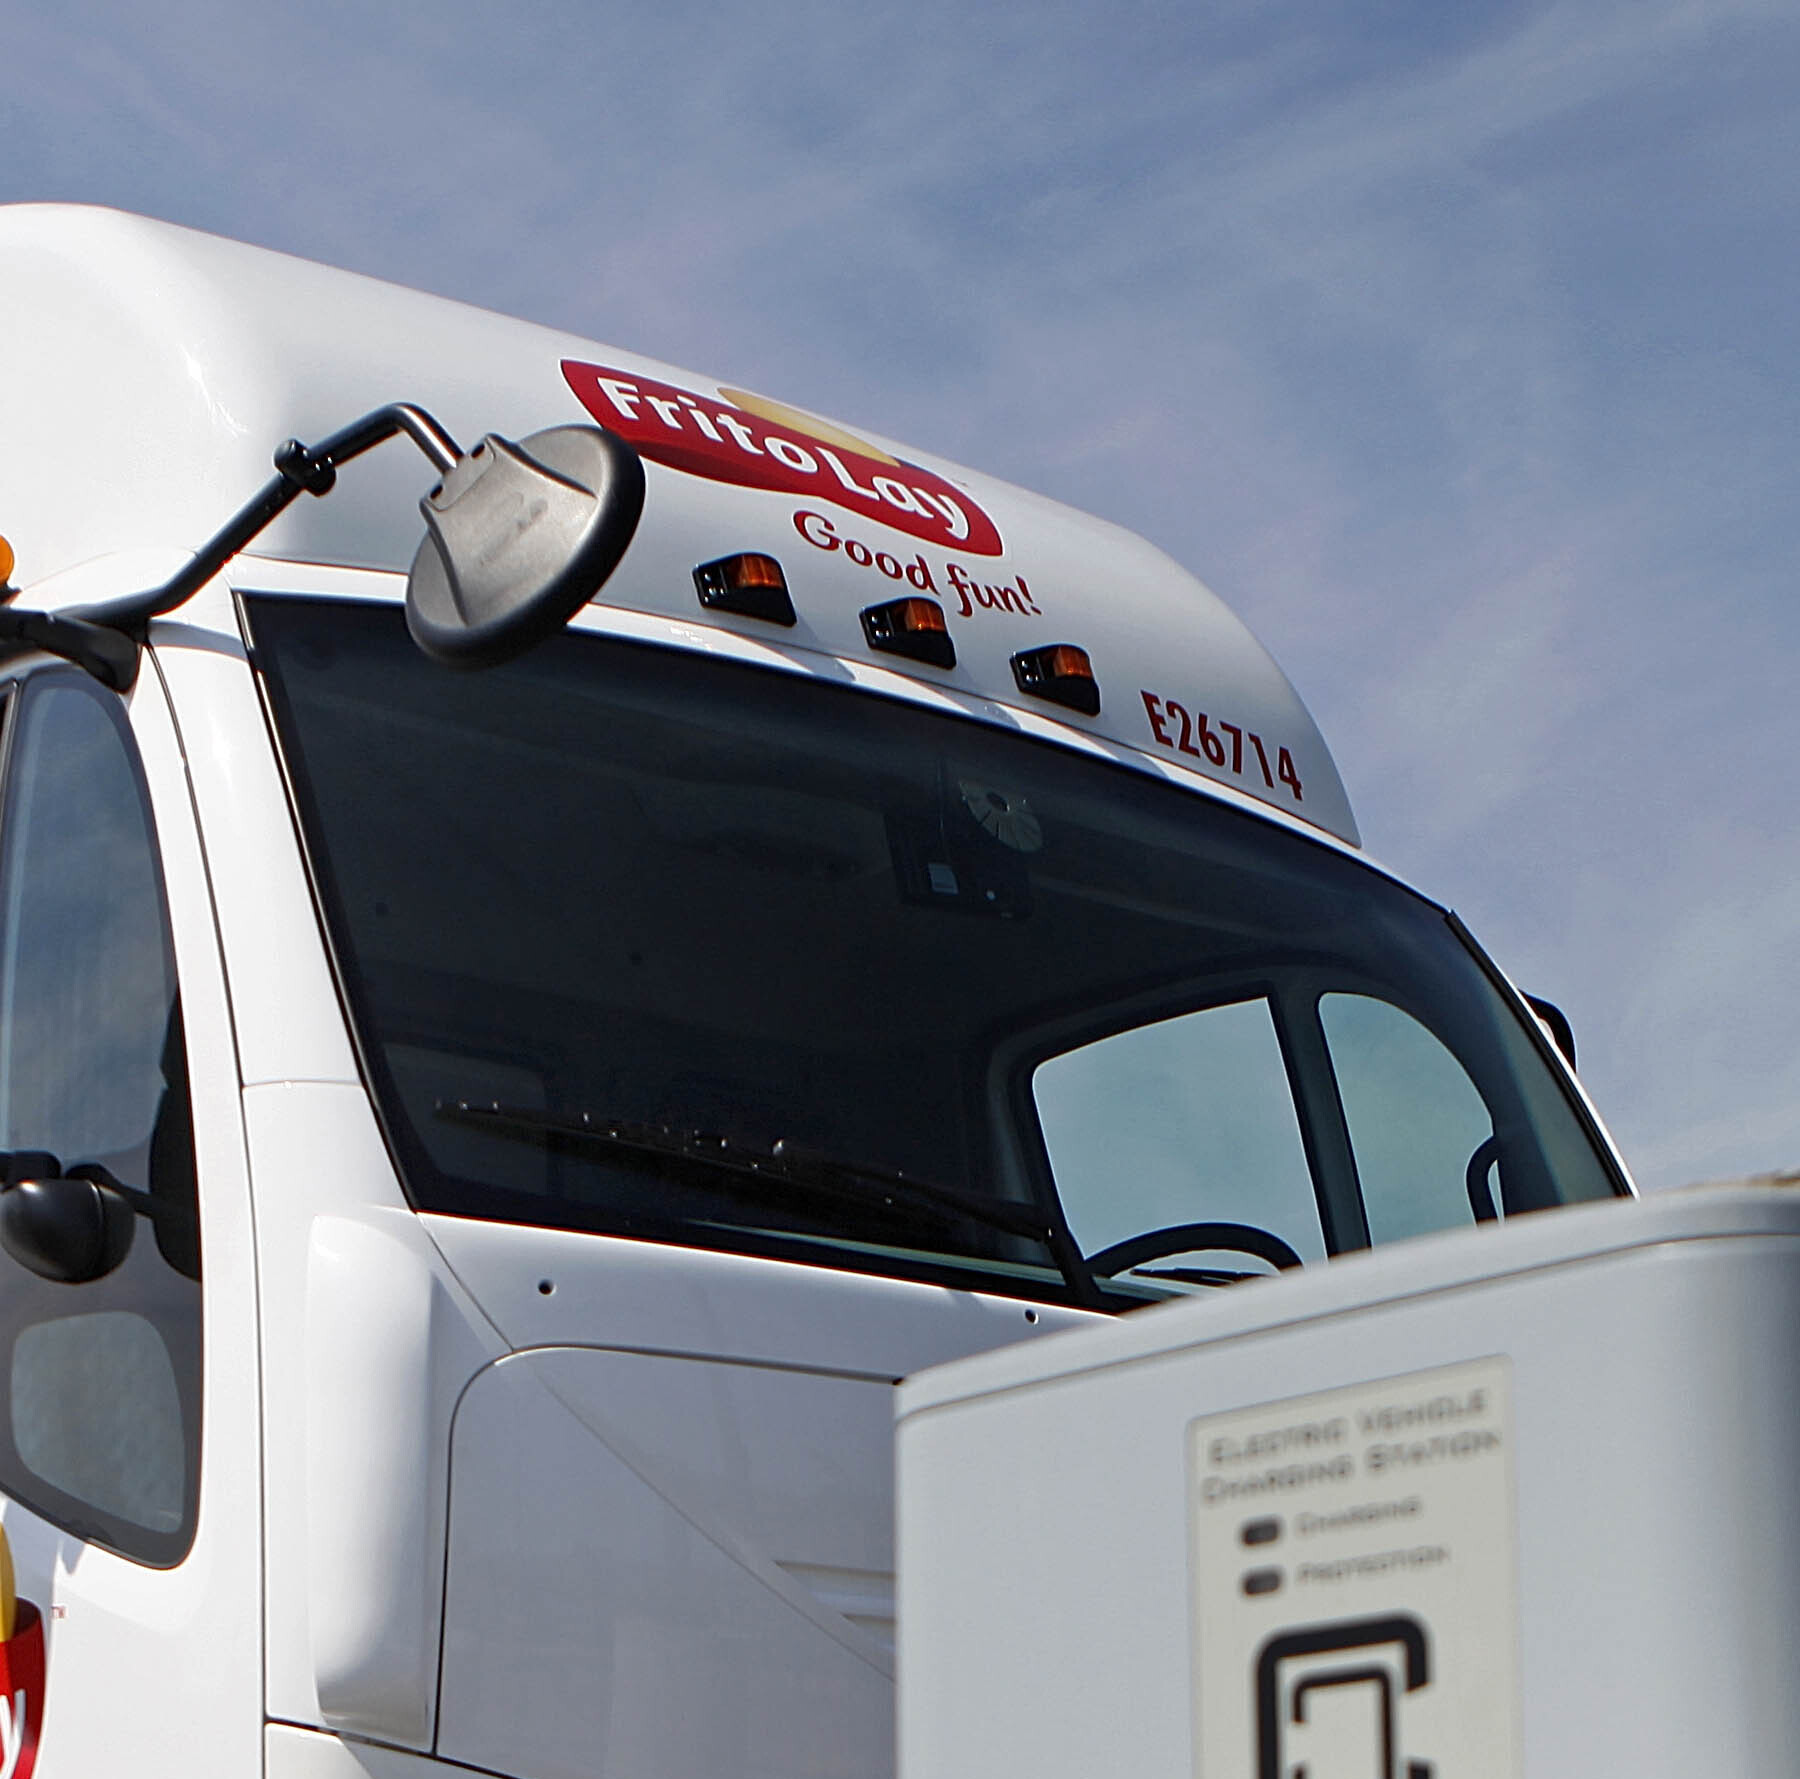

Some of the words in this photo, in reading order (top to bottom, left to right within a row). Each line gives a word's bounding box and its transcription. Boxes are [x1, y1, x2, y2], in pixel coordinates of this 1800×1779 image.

[793, 510, 939, 596] Good
[948, 563, 1042, 618] fun!
[1140, 690, 1304, 802] E26714
